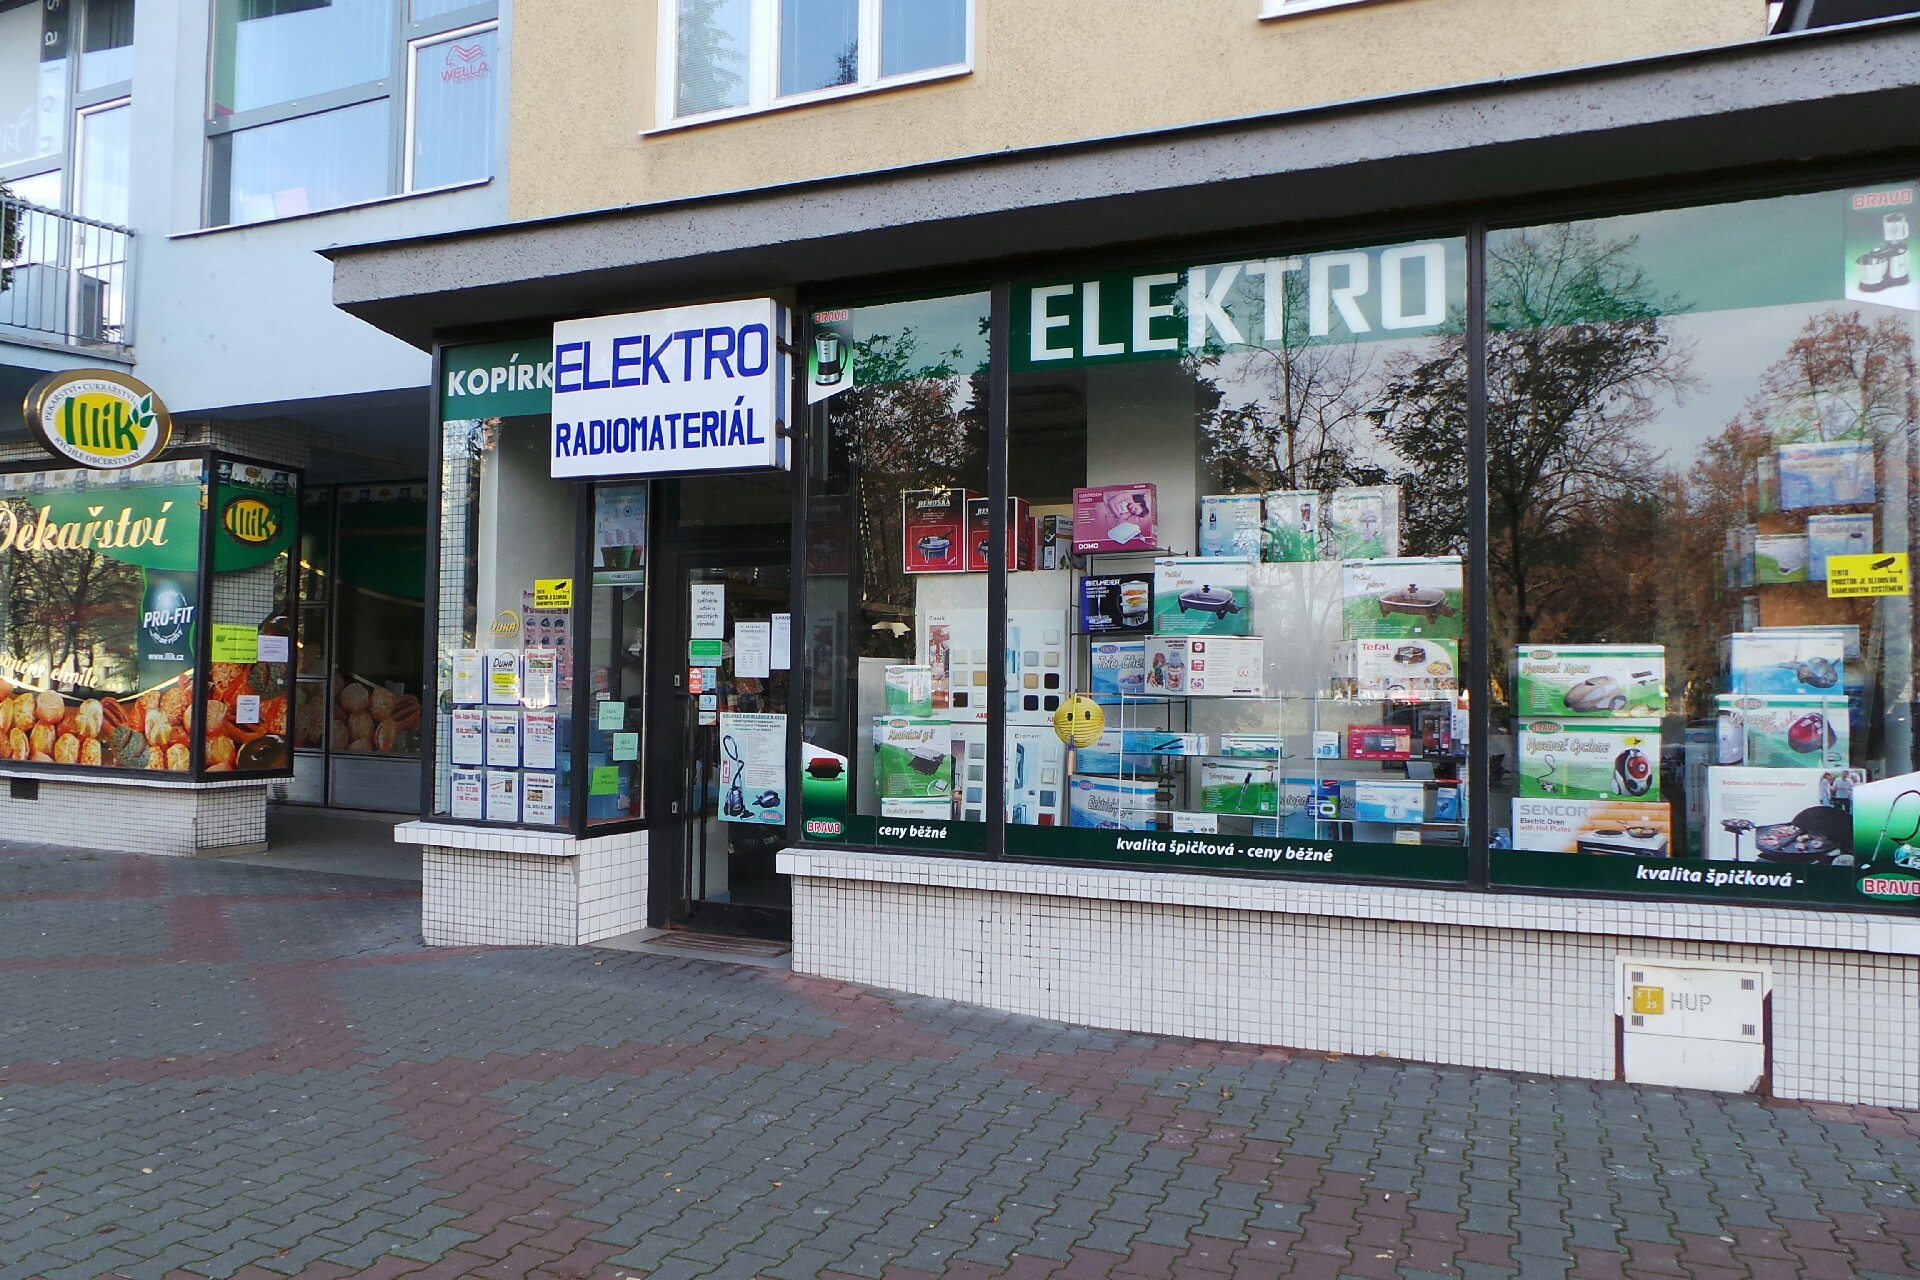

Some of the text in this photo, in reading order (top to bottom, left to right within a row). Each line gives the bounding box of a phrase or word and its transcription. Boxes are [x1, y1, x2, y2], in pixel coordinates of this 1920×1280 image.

[441, 61, 489, 81] WELLA
[1852, 189, 1912, 209] BRAVO
[1030, 243, 1446, 362] ELEKTRO
[814, 309, 849, 323] BRAVO
[554, 322, 769, 394] ELEKTRO
[555, 395, 765, 458] RADIOMATERIÁL
[143, 606, 194, 628] PRO-FIT
[1361, 643, 1391, 651] Tefal
[1098, 656, 1118, 670] Trio
[1531, 723, 1559, 732] BRAVO
[1526, 737, 1611, 756] Vysavač Cyclone
[1520, 804, 1589, 818] SENCOR
[806, 820, 842, 835] BRAVO
[1520, 817, 1565, 826] Electric Oven
[878, 824, 948, 839] ceny běžné
[1116, 837, 1166, 853] kvalita
[1168, 842, 1235, 856] špičková
[1246, 845, 1283, 862] ceny
[1284, 846, 1334, 862] běžné
[1635, 864, 1702, 883] kvalita
[1704, 869, 1793, 887] špičková
[1863, 879, 1920, 896] BRAVO
[1670, 992, 1713, 1012] HUP
